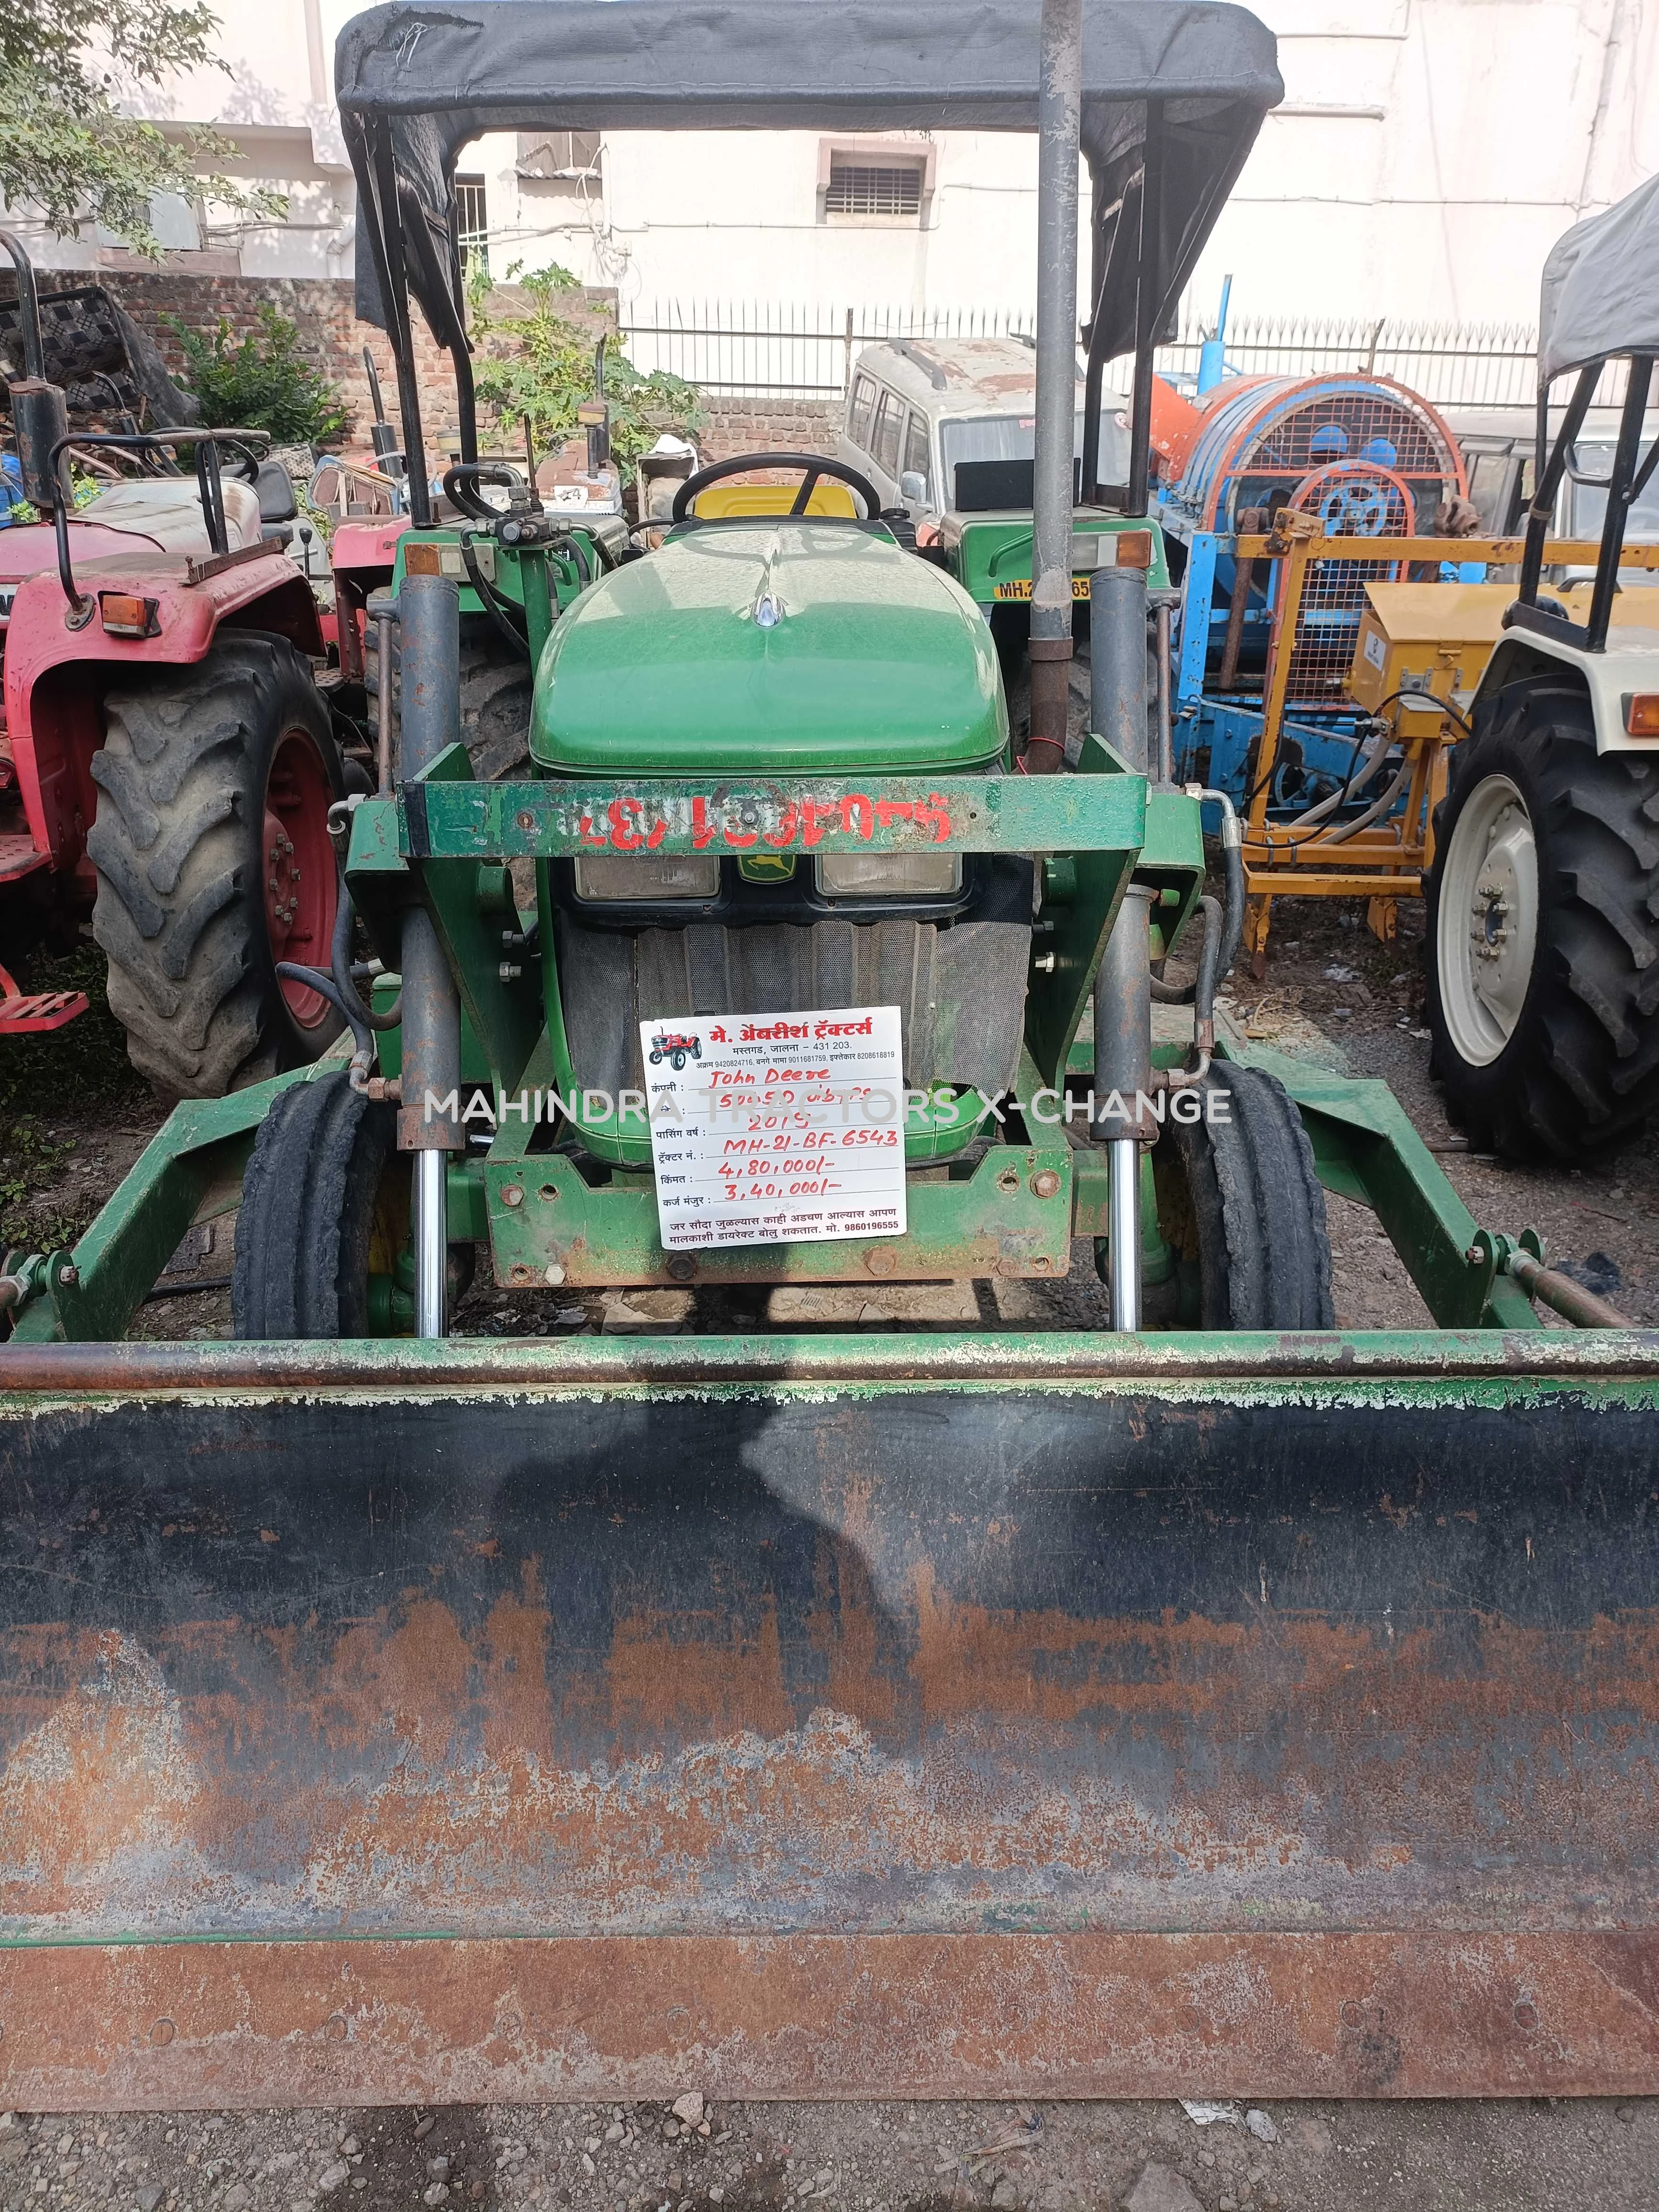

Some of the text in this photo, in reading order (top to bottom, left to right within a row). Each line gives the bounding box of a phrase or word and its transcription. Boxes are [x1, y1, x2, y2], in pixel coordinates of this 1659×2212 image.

[1072, 581, 1091, 597] 65
[708, 1025, 733, 1043] मे.
[813, 1017, 873, 1040] ट्रॅक्टर्स
[732, 1046, 766, 1055] मस्तगड,
[770, 1044, 799, 1053] जालना
[813, 1042, 829, 1051] 431
[832, 1041, 852, 1050] 203.
[715, 1059, 754, 1068] 9420824716,
[788, 1054, 828, 1063] 9011681759,
[829, 1052, 856, 1062] इफ्तेकार
[857, 1051, 895, 1060] 8208618819
[709, 1069, 830, 1089] John Deere
[655, 1128, 683, 1139] पासिंग
[686, 1126, 699, 1137] वर्ष
[658, 1151, 683, 1164] ट्रॅक्टर
[685, 1150, 696, 1160] नं.
[718, 1156, 834, 1179] 4,80,000/-
[660, 1174, 686, 1185] किंमत
[724, 1179, 842, 1201] 3,40,000/-
[662, 1196, 680, 1207] कर्ज
[683, 1195, 704, 1207] मंजुर
[669, 1208, 897, 1231] जर सौदा जुळल्यास काही अडचण आल्यास आपण
[668, 1221, 898, 1244] मालकाशी डायरेक्ट बोलु शकतात. मो. 9860196555
